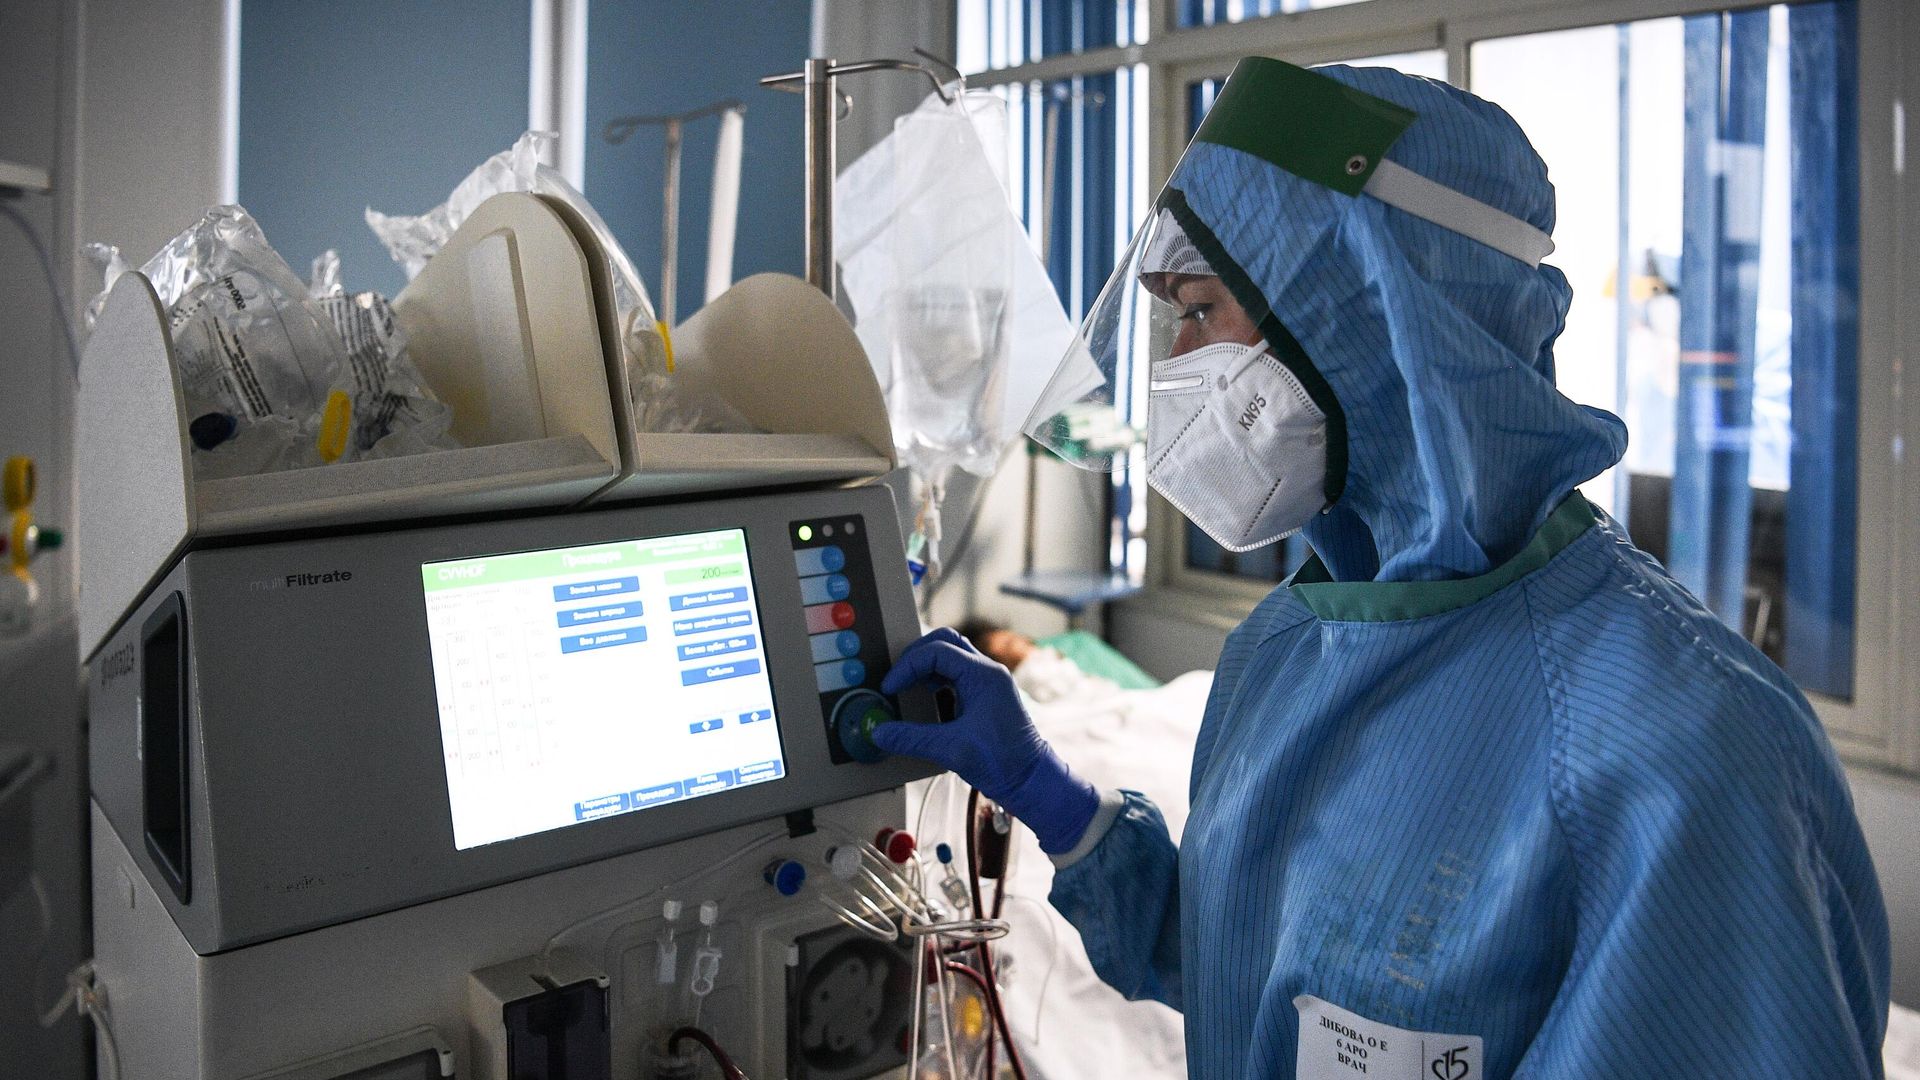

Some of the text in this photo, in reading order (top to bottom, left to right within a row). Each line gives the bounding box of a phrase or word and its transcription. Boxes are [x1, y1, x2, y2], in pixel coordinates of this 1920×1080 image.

[1239, 392, 1267, 431] KN95
[701, 566, 721, 580] 200
[1319, 1016, 1388, 1052] ДИБОВА О Е
[1336, 1039, 1367, 1059] 6 АРО
[1337, 1052, 1367, 1074] ВРАЧ
